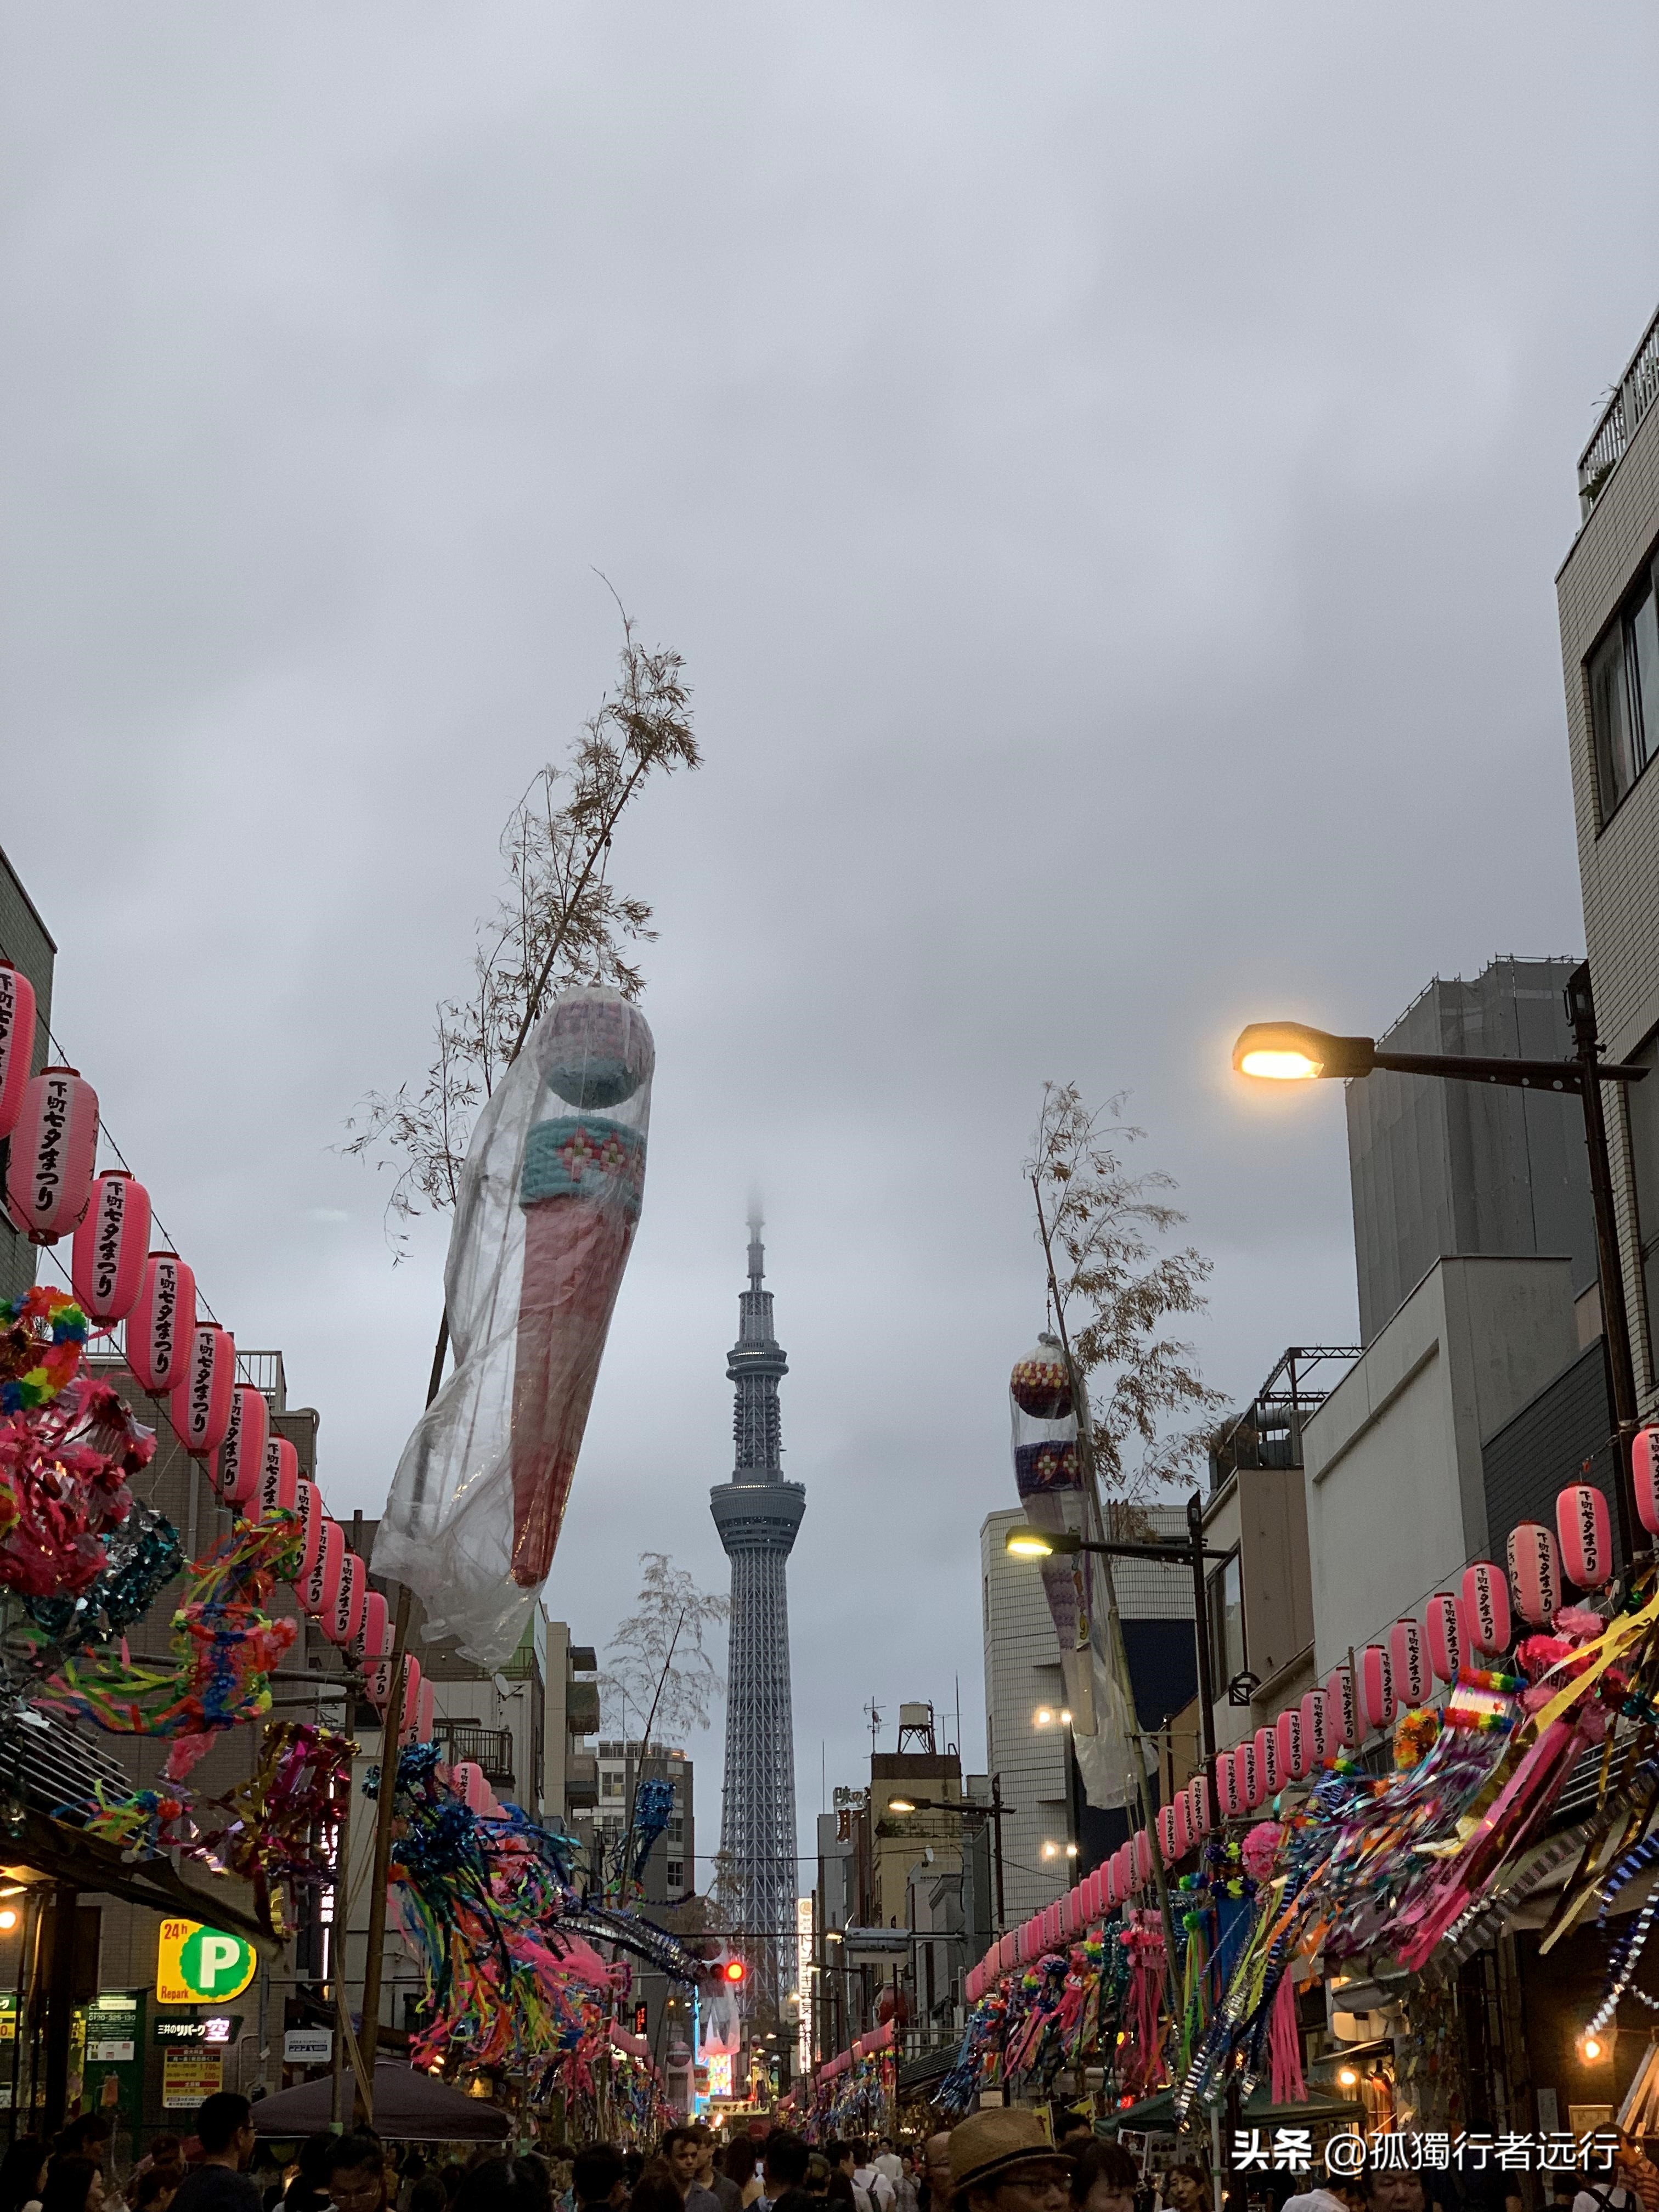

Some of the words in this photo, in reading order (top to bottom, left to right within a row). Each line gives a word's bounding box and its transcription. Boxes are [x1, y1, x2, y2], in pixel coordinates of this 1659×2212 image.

[35, 1081, 67, 1211] 下町七夕まつり
[96, 1182, 124, 1297] 下町七夕まつり
[154, 1265, 176, 1374] 下町七夕まつり
[192, 1333, 213, 1432] 下町七夕まつり
[1579, 1491, 1597, 1572] 下町七夕まつり
[337, 1558, 353, 1632] 下町七夕まつり
[1537, 1532, 1553, 1612] 下町七夕まつり
[1443, 1600, 1459, 1669] 下町七夕まつり
[1476, 1567, 1493, 1640] 下町七夕まつり
[1381, 1653, 1393, 1717] 下町七夕まつり
[1407, 1629, 1421, 1696] 下町七夕まつり
[1314, 1697, 1324, 1754] 下町七夕まつり
[1342, 1677, 1353, 1738] 下町七夕まつり
[1246, 1747, 1256, 1800] 下町七夕まつり
[1266, 1731, 1276, 1786] 下町七夕まつり
[1291, 1715, 1301, 1770] 下町七夕まつり
[1194, 1781, 1203, 1829] 下町七夕まつり
[1228, 1759, 1237, 1809] 下町七夕まつり
[164, 1923, 188, 1939] 24h
[161, 1986, 189, 2000] Repark
[200, 1937, 240, 1988] P
[157, 2024, 205, 2036] 三井のリパーク
[204, 2018, 230, 2041] 空
